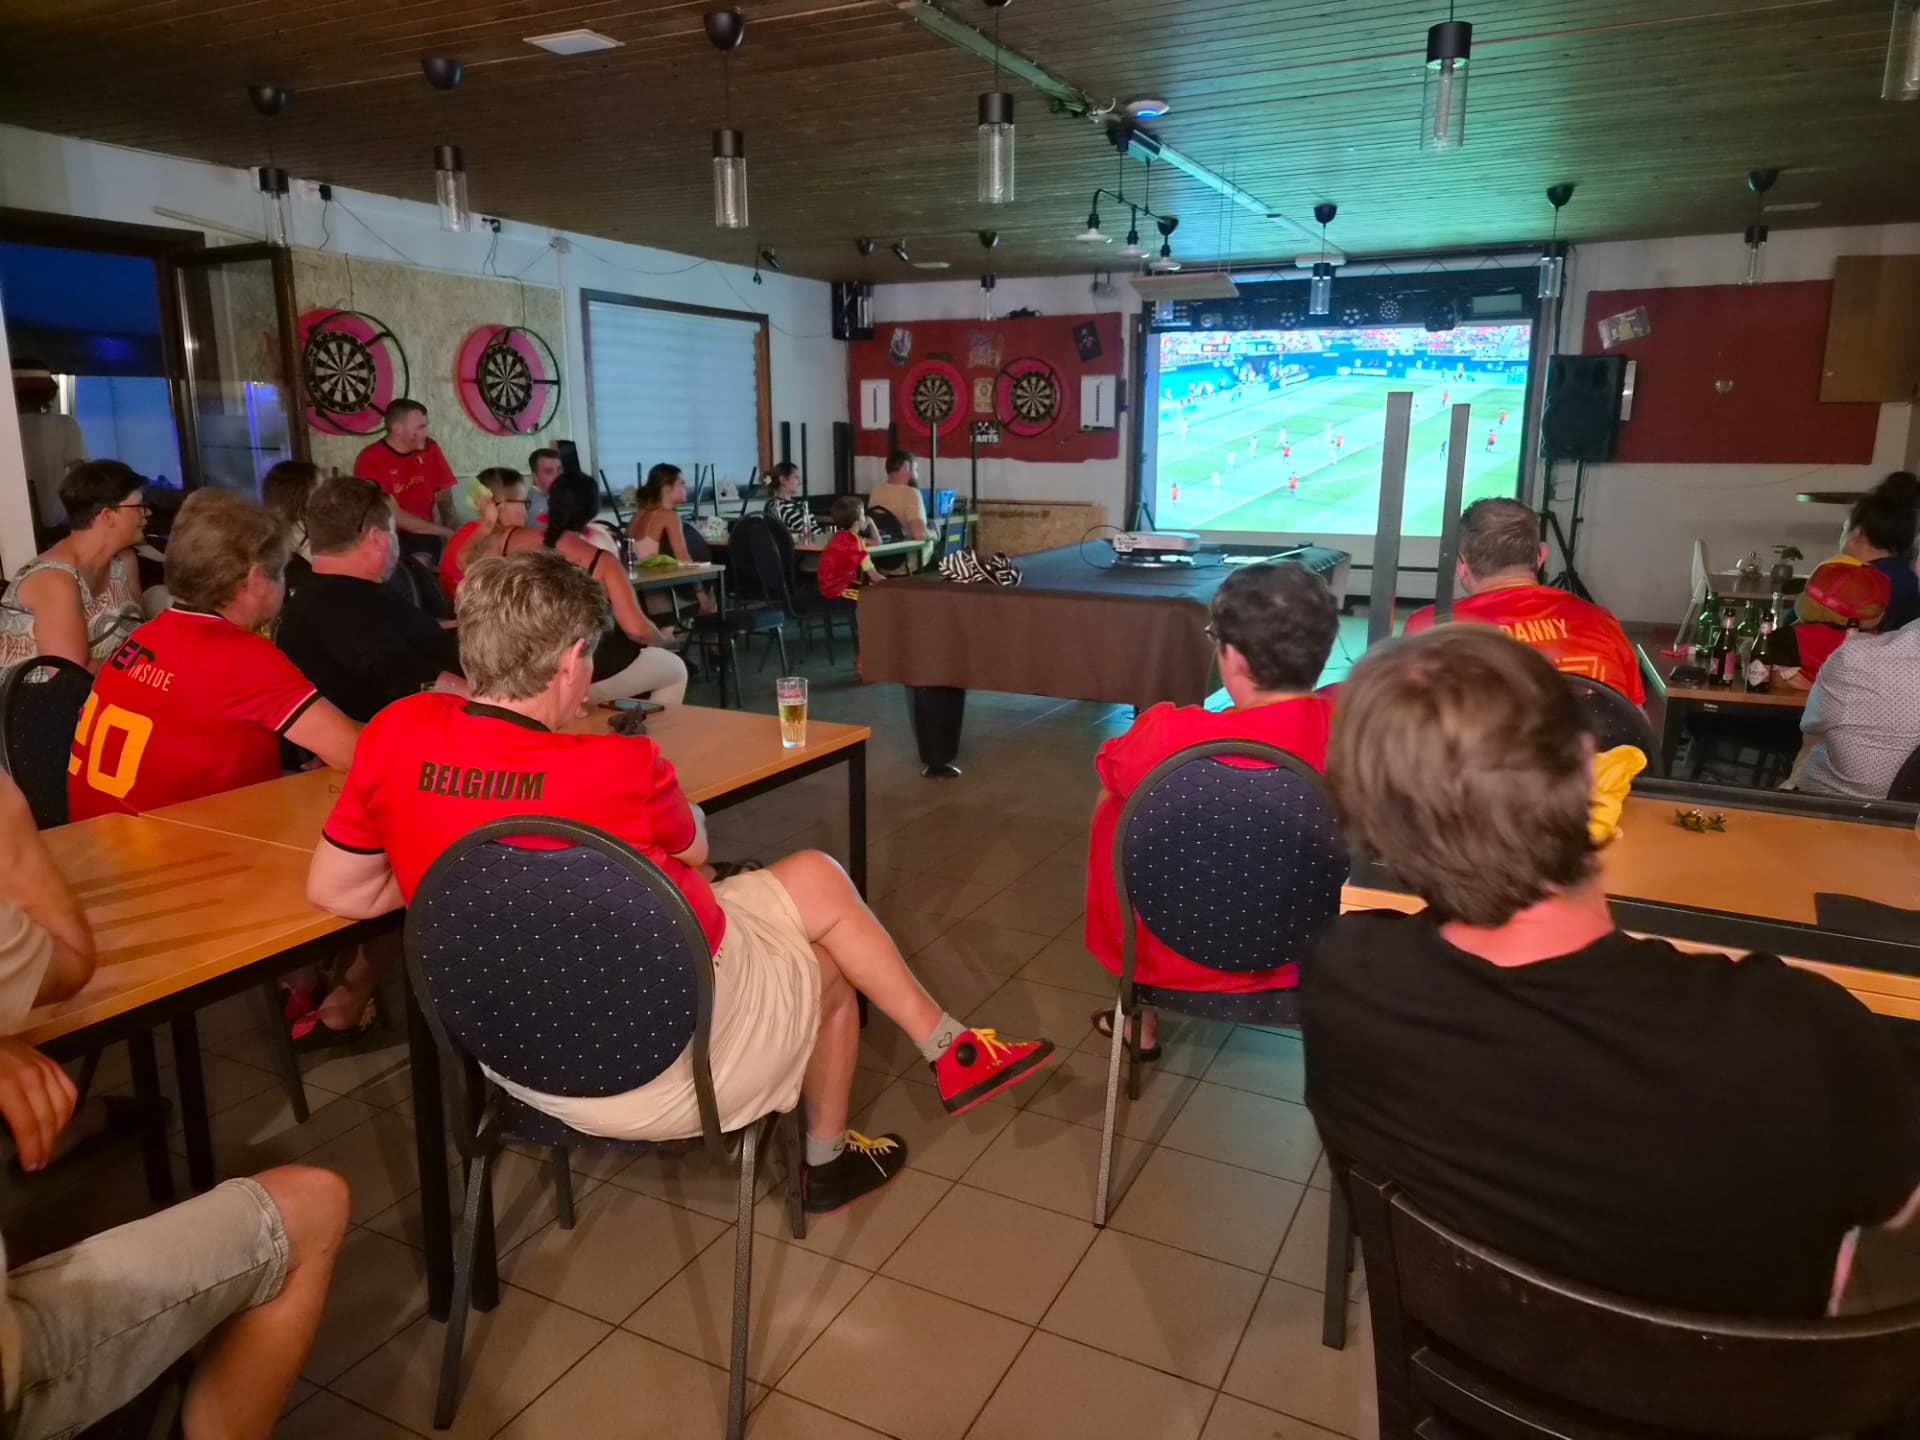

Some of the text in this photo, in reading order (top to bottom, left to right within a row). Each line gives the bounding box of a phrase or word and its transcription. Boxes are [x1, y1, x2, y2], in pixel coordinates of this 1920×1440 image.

[109, 636, 155, 670] ED
[128, 663, 175, 692] INSIDE
[417, 760, 546, 801] BELGIUM
